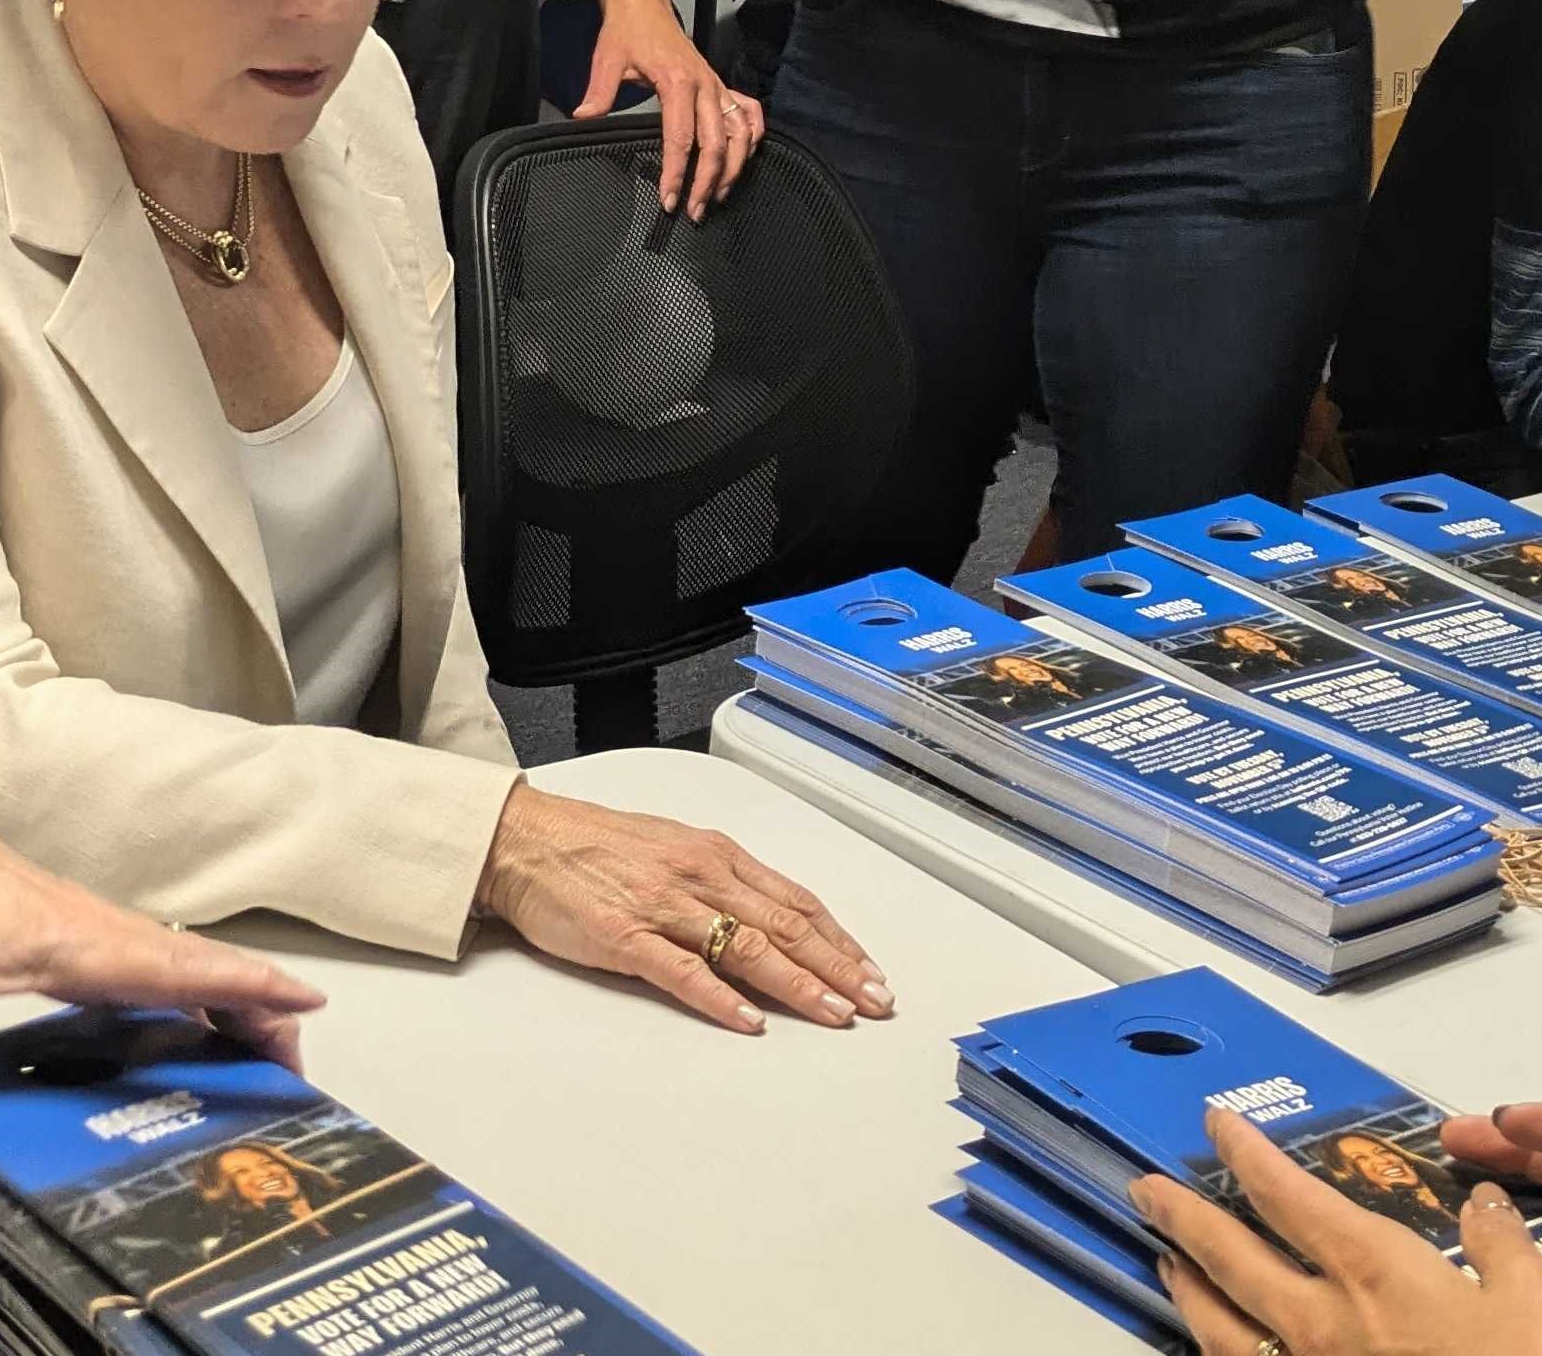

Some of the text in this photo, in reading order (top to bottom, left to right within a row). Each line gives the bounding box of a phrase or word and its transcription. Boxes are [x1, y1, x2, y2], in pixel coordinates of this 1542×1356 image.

[1440, 518, 1501, 537] HARRIS
[1251, 542, 1314, 563] HARRIS
[1278, 550, 1319, 565] WALZ
[1135, 598, 1203, 620] HARRIS
[1164, 608, 1208, 622] WALZ
[899, 626, 974, 652] HARRIS
[929, 637, 978, 655] WALZ
[1205, 1076, 1307, 1113] HARRIS
[1247, 1097, 1314, 1122] WALZ
[245, 1228, 489, 1338] PENNSYLVANIA,
[296, 1253, 489, 1345] VOTE FOR A NEW
[318, 1269, 511, 1356] WAY FORWARD!
